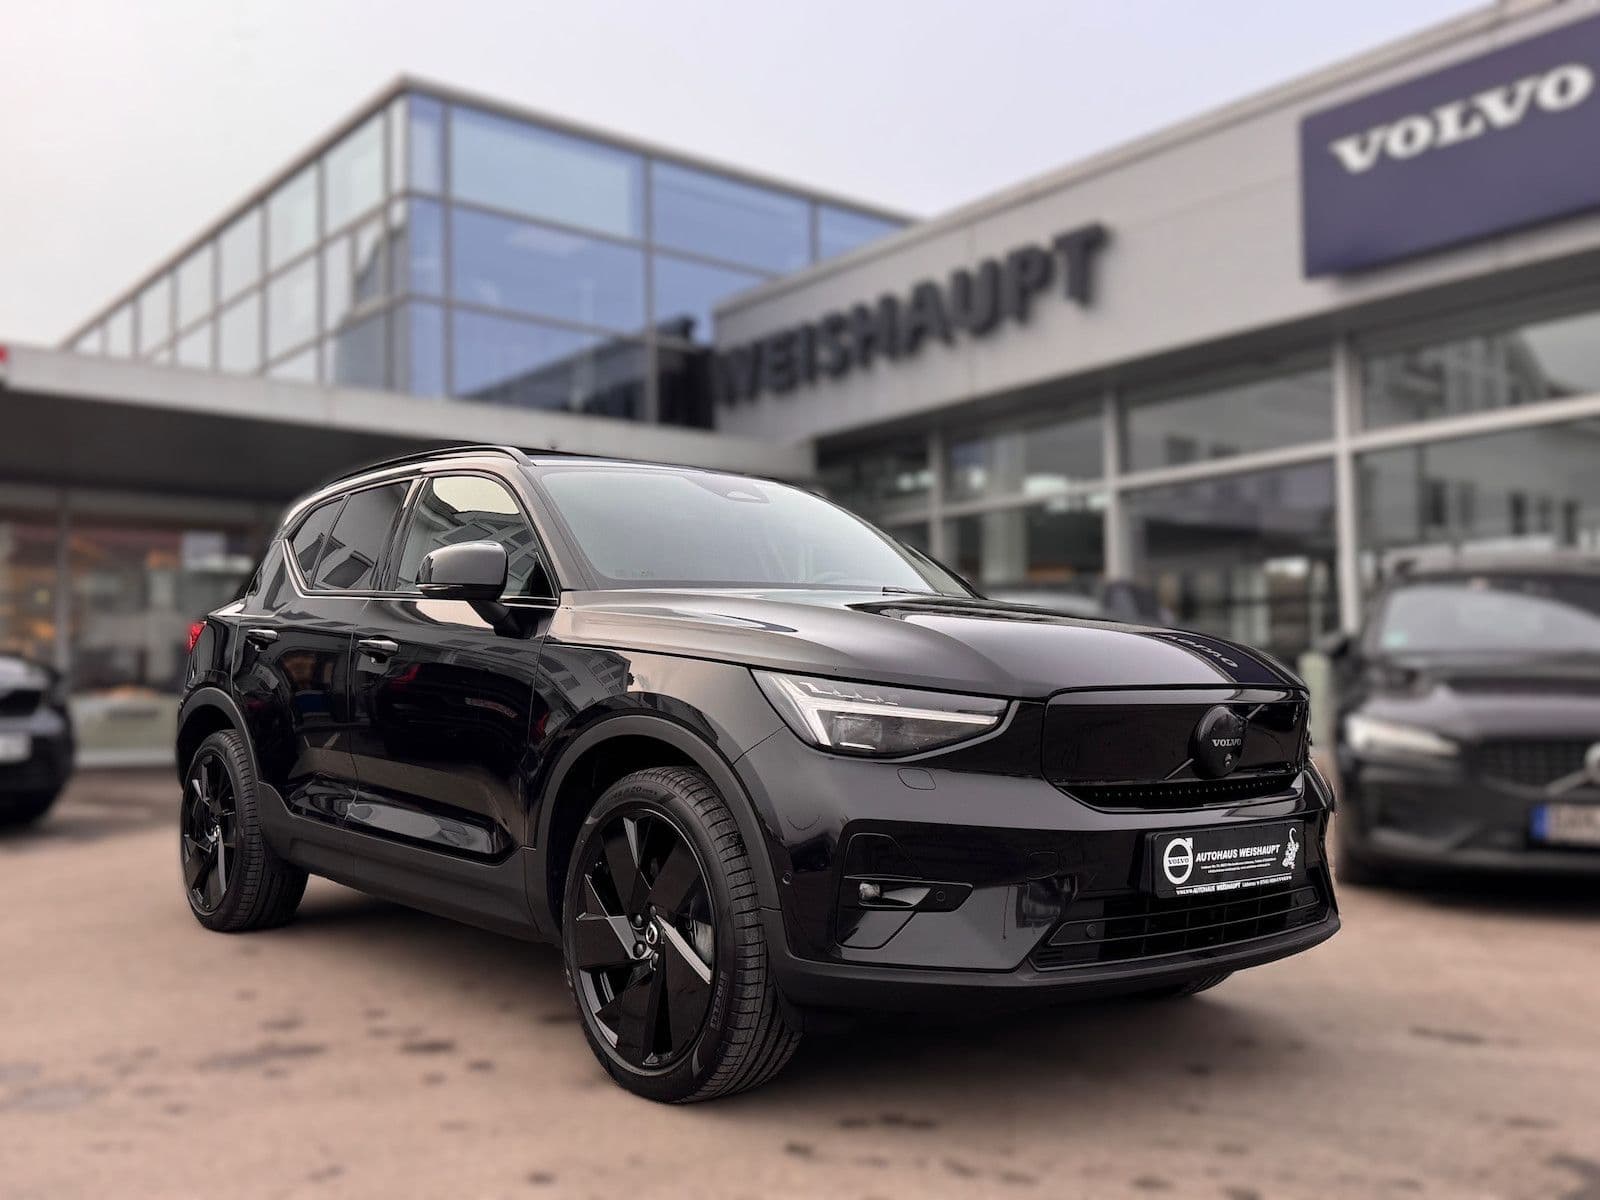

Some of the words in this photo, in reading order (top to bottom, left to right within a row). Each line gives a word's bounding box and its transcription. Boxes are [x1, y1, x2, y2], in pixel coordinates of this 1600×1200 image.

[1329, 64, 1593, 173] VOLVO
[714, 223, 1109, 408] WEISHAUPT
[1211, 738, 1242, 747] VOLVO
[1168, 857, 1190, 865] VOLVO
[1195, 849, 1238, 863] AUTOHAUS
[1239, 844, 1280, 858] WEISHAUPT
